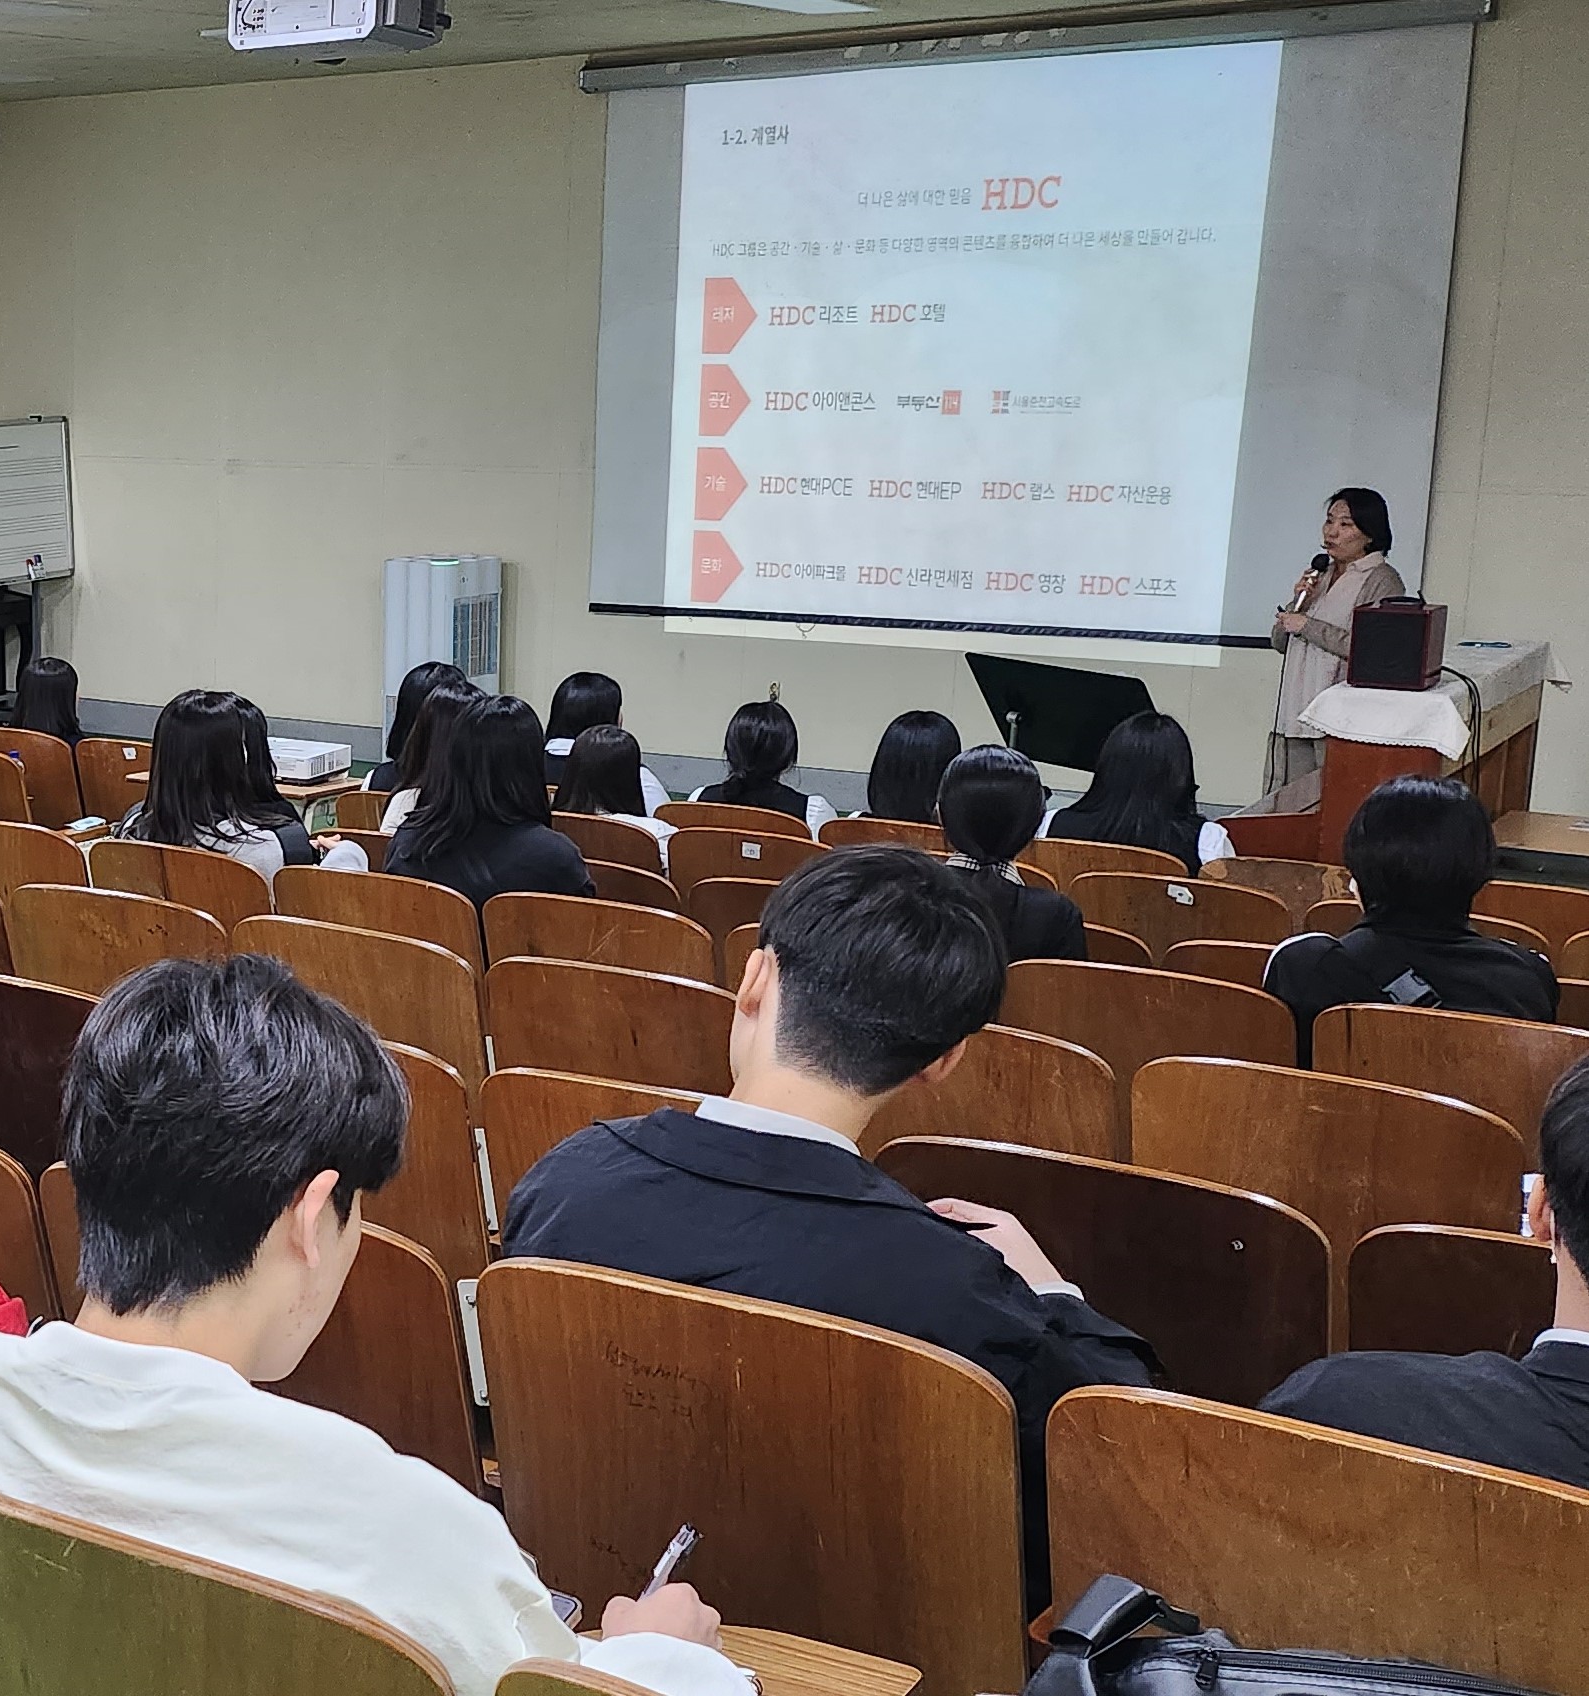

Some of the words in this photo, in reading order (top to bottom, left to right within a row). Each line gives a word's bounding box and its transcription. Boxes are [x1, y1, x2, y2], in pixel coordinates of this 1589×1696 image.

[721, 128, 747, 146] 1-2.
[751, 124, 790, 146] 계열사
[981, 175, 1062, 211] HDC
[712, 242, 735, 258] HDC
[768, 305, 816, 326] HDC
[818, 304, 859, 324] 리조트
[869, 303, 917, 324] HDC
[919, 302, 946, 323] 호텔
[708, 390, 732, 409] 공간
[764, 391, 809, 411] HDC
[812, 390, 877, 412] 아이앤콘스
[704, 475, 728, 493] 기술
[759, 475, 797, 495] HDC
[800, 477, 854, 497] 현대PCE
[867, 479, 913, 499] HDC
[916, 481, 962, 501] 현대EP
[981, 481, 1027, 500] HDC
[1066, 484, 1115, 503] HDC
[1118, 484, 1173, 506] 자산운용
[700, 556, 723, 575] 문화
[755, 561, 792, 579] HDC
[856, 565, 903, 586] HDC
[906, 566, 974, 590] 신라면세점
[984, 570, 1034, 593] HDC
[1078, 574, 1131, 597] HDC
[1133, 576, 1178, 598] 스포츠
